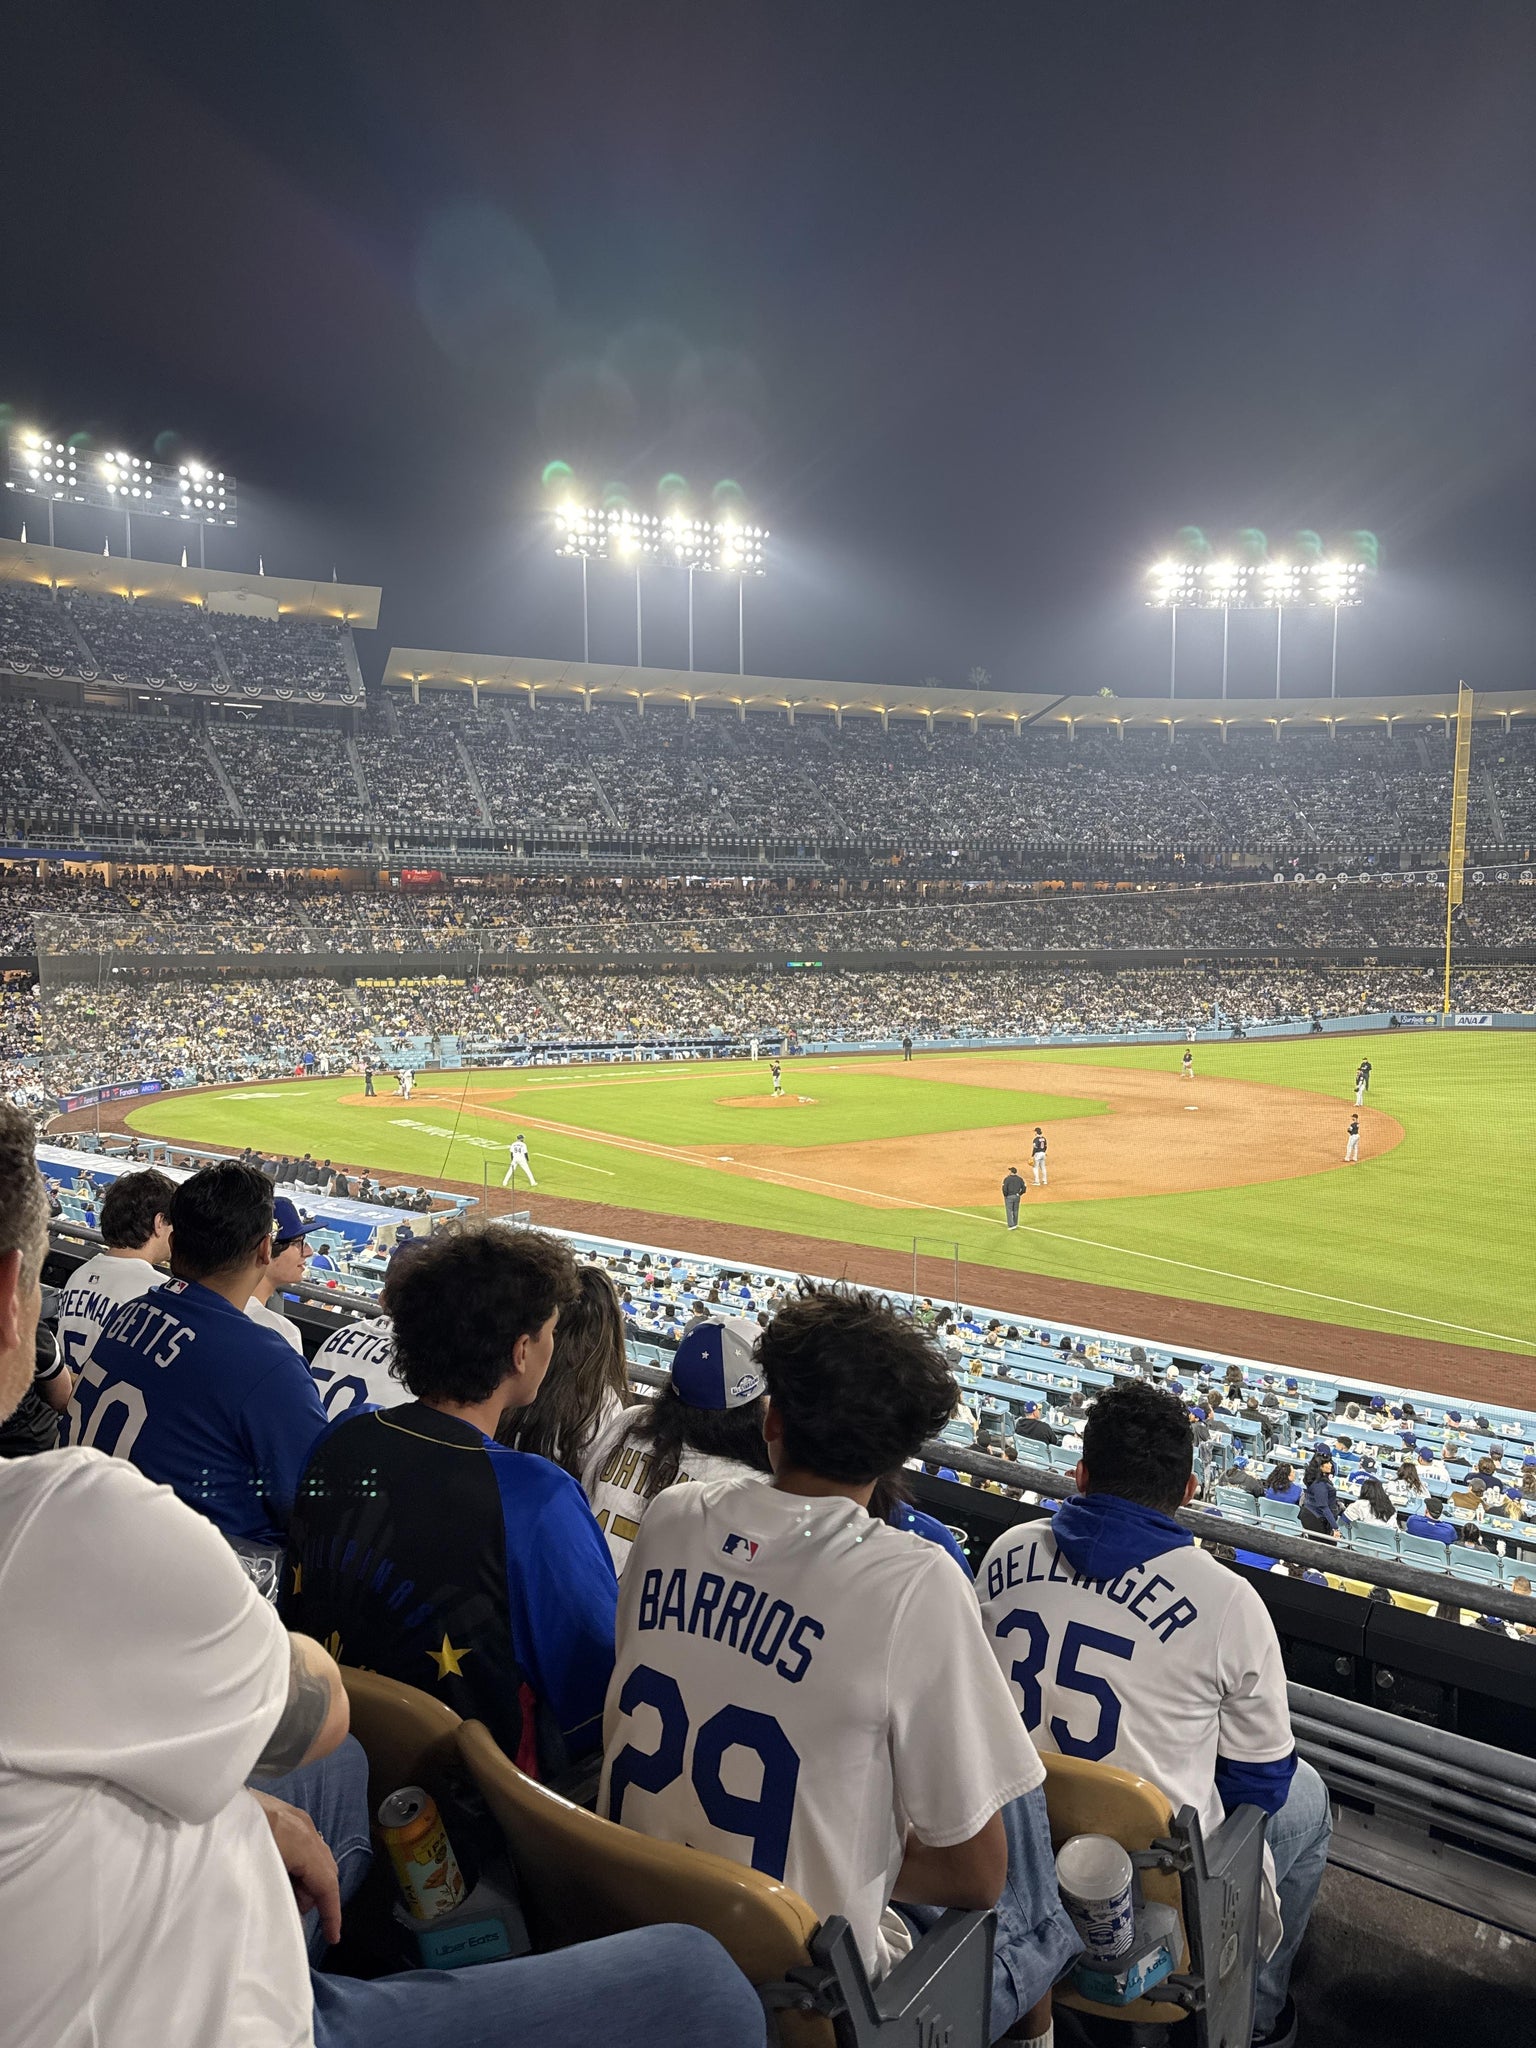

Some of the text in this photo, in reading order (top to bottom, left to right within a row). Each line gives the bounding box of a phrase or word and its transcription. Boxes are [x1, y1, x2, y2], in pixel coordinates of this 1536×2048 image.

[119, 1087, 139, 1097] Fanatics
[141, 1083, 155, 1092] ARCO
[59, 1289, 120, 1328] REEMAN
[106, 1302, 196, 1368] BETTS
[324, 1328, 391, 1365] BETTS
[311, 1366, 369, 1410] 0
[599, 1444, 698, 1500] OHTA
[987, 1541, 1198, 1643] BELLGER
[638, 1568, 825, 1684] BARRIOS
[995, 1608, 1136, 1762] 35
[609, 1663, 801, 1883] 29
[434, 1932, 500, 1956] Uber Eats
